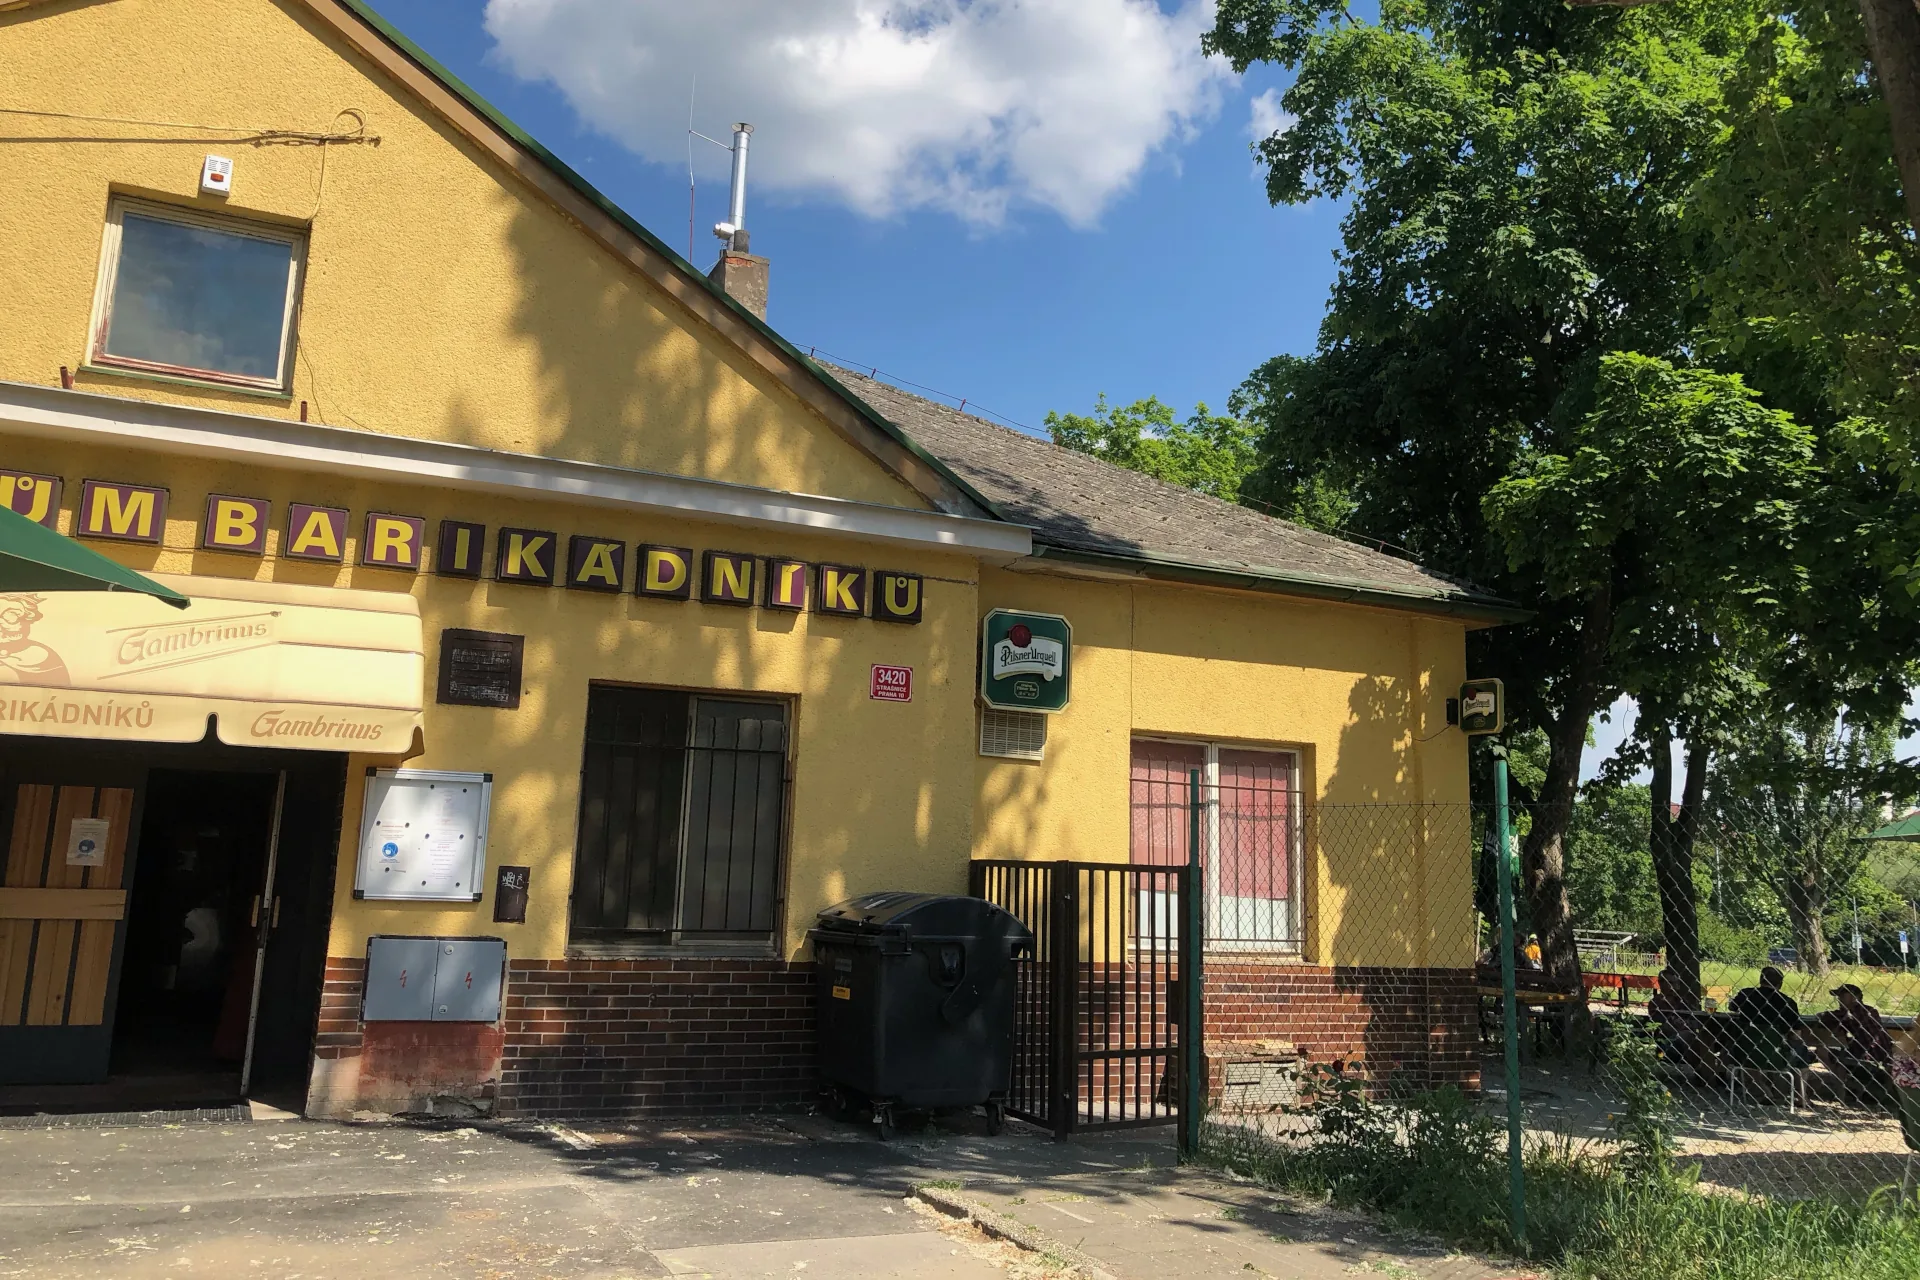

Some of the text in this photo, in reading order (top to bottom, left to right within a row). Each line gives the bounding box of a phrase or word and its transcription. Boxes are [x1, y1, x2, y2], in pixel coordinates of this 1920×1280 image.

[213, 500, 918, 616] BARIKÁDNÍKŮ
[117, 623, 268, 666] Gambrinus
[1000, 645, 1057, 667] Pilsner Urquell
[878, 669, 906, 684] 3420
[250, 709, 384, 741] Gambrinus
